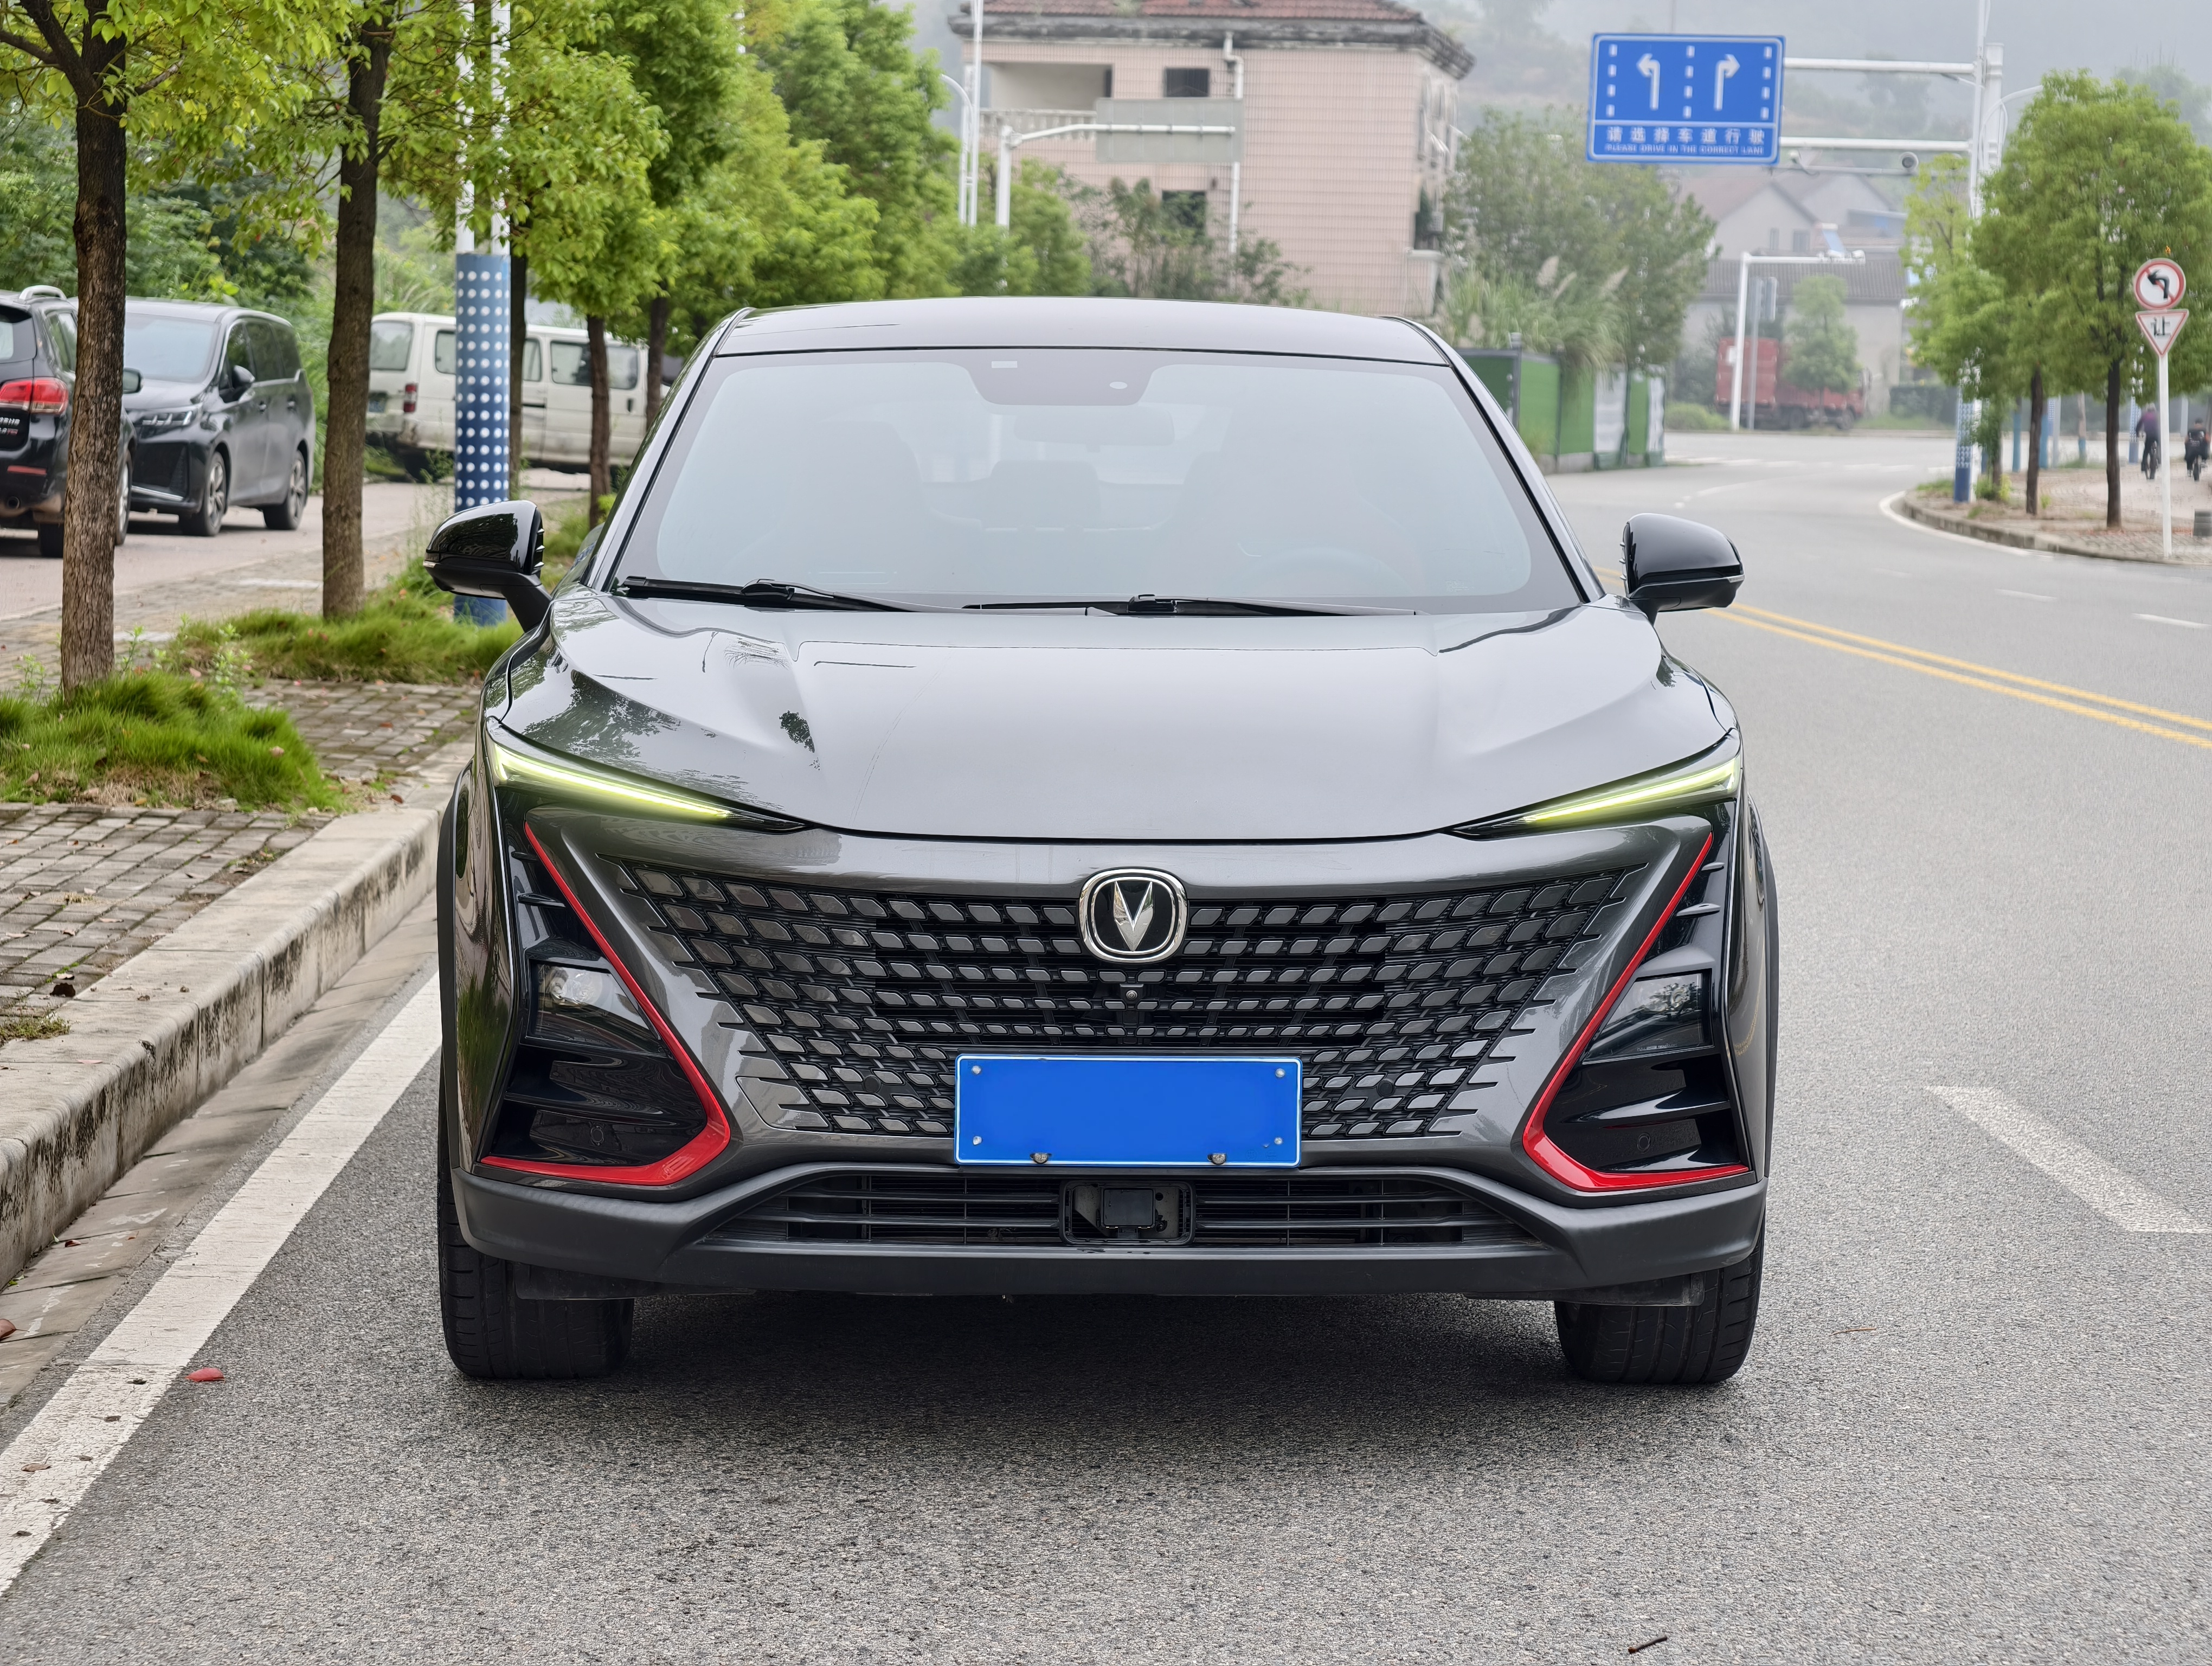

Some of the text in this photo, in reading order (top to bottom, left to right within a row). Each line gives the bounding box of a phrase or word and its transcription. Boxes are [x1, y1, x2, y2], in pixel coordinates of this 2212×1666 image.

[1606, 144, 1764, 155] PLEASE DRIVE IN THE CORRECT LANE
[2151, 315, 2172, 337] 让
